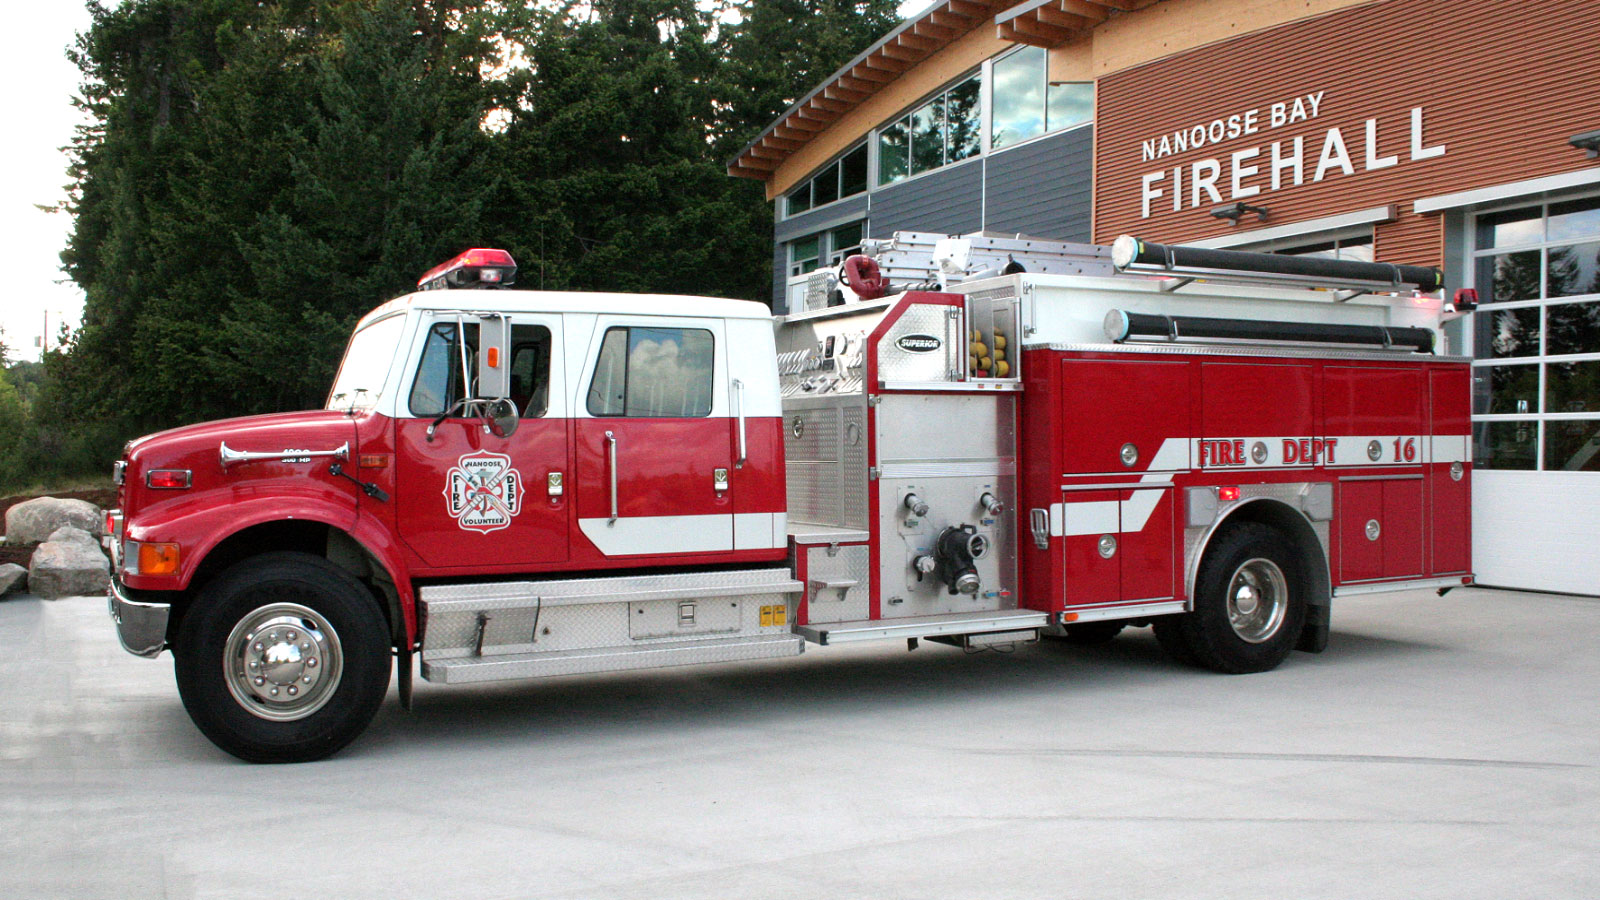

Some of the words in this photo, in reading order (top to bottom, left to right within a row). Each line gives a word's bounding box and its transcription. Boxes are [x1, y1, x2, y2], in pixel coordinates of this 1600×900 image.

[1142, 109, 1259, 162] NANOOSE
[1271, 91, 1324, 128] BAY
[1142, 107, 1446, 218] FIREHALL
[901, 339, 938, 348] SUPERIOR
[1198, 440, 1246, 466] FIRE
[1282, 438, 1337, 464] DEPT
[1393, 437, 1416, 462] 16
